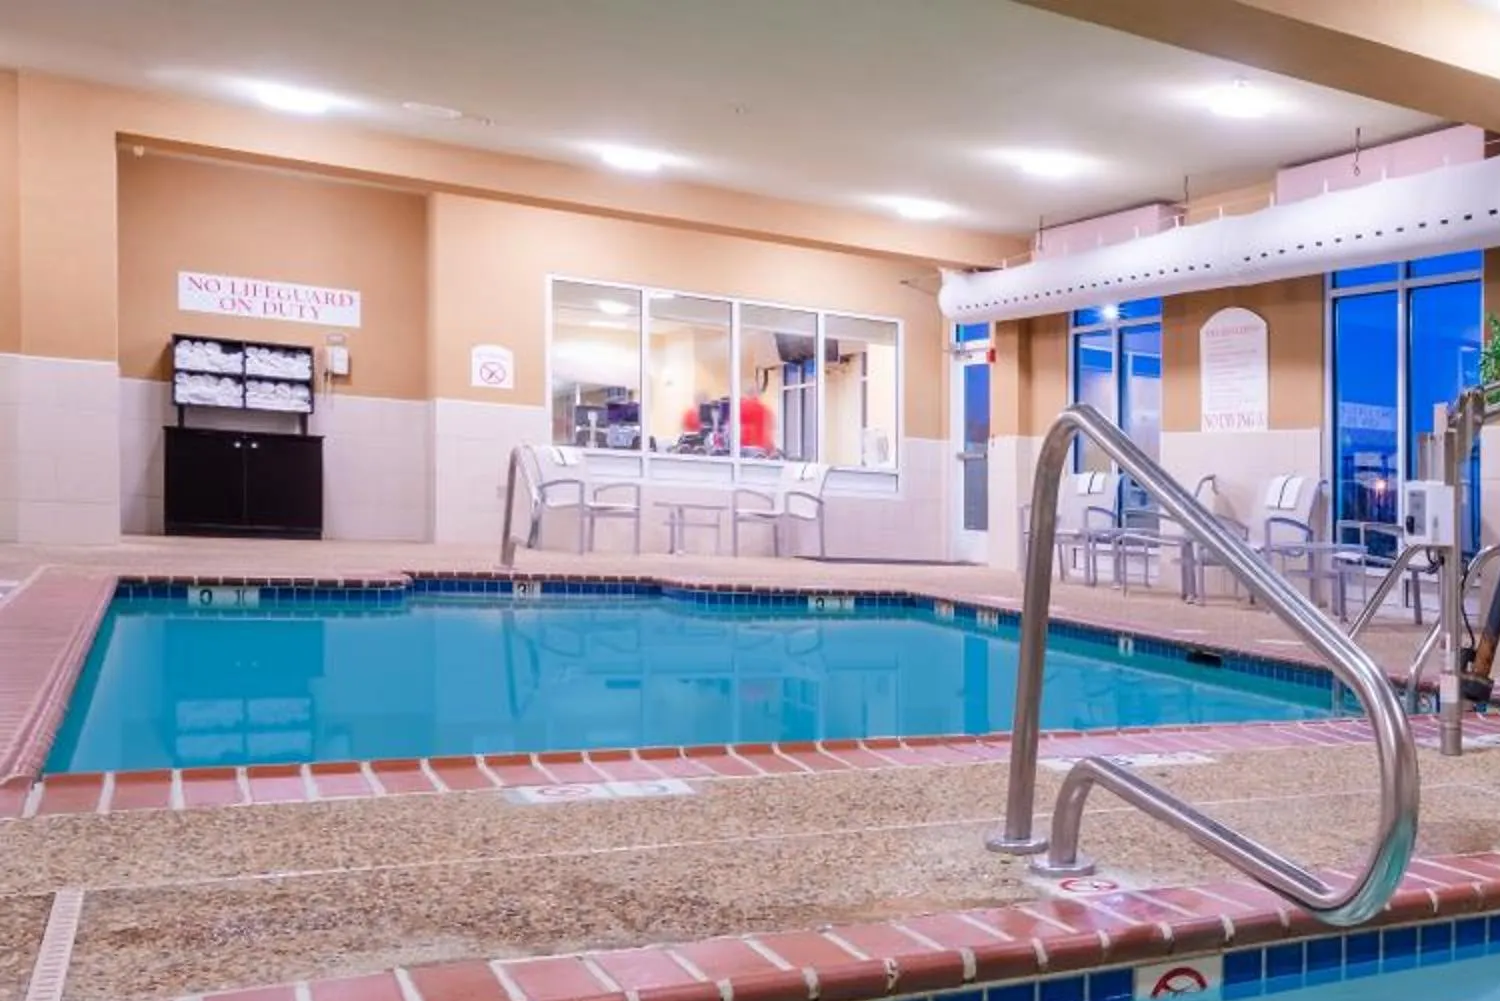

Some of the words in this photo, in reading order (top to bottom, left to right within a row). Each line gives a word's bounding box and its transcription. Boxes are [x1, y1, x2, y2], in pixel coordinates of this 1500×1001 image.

[187, 276, 221, 293] NO
[230, 280, 354, 307] LIFEGUARD
[219, 297, 252, 313] ON
[262, 301, 319, 320] DUTY
